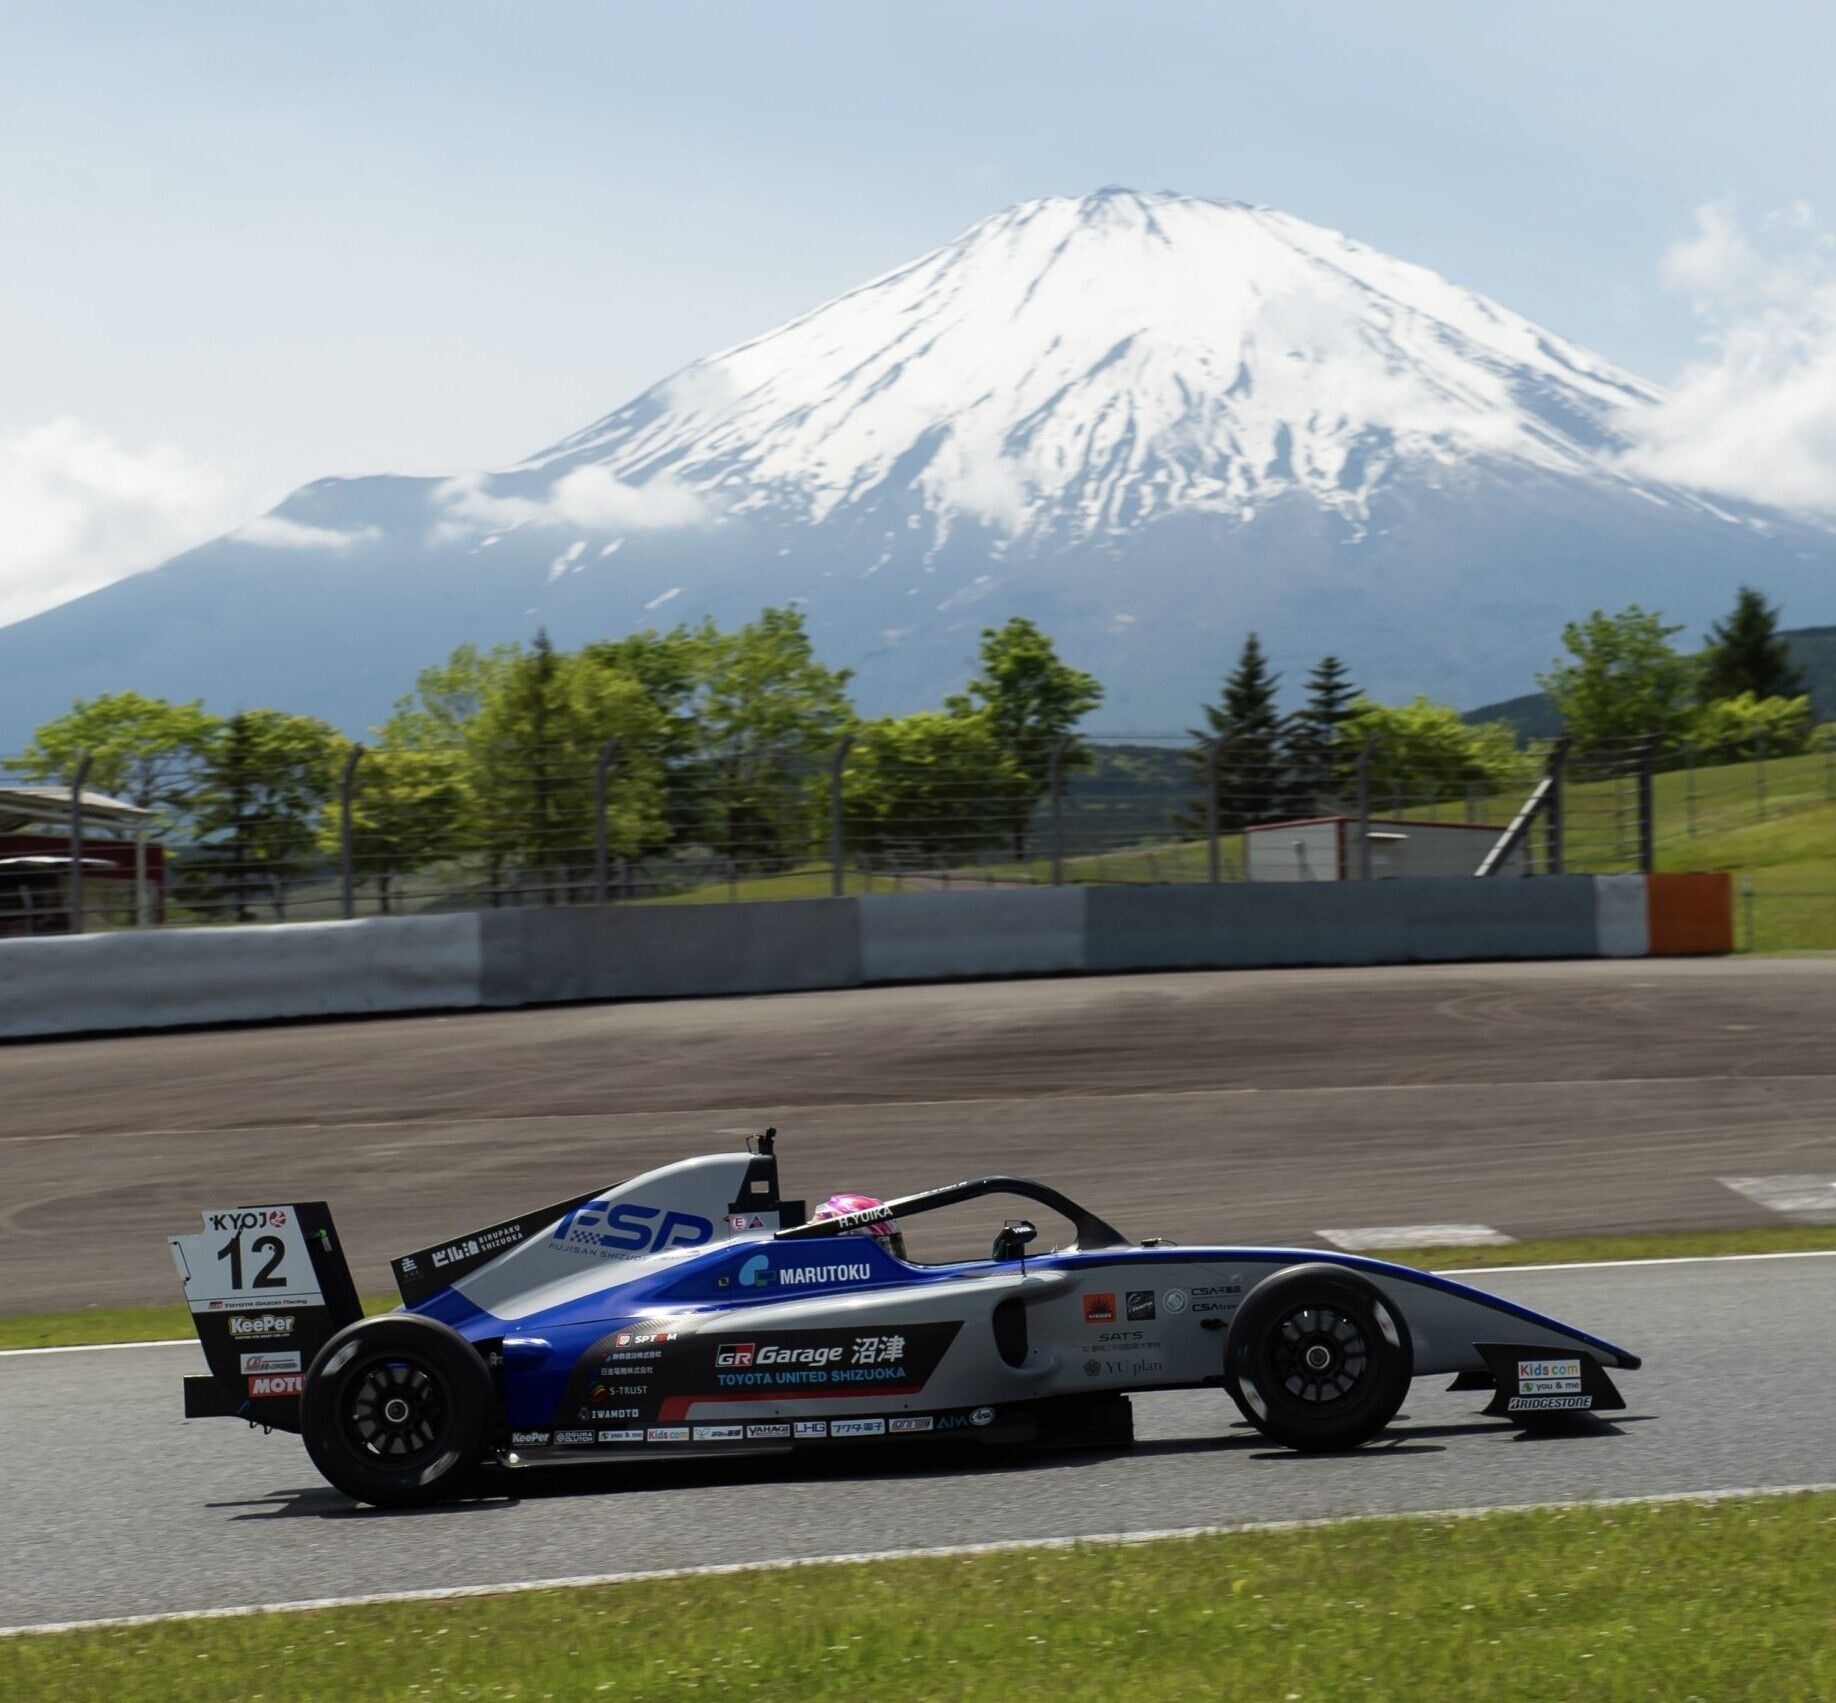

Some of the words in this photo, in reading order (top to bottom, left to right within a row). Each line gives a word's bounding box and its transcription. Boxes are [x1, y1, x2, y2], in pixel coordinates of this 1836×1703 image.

[553, 1200, 714, 1253] FSP
[838, 1206, 894, 1229] H.YUIKA
[480, 1232, 523, 1252] SHIZUOKA
[217, 1235, 288, 1290] 12
[779, 1263, 871, 1285] MARUTOKU
[230, 1314, 295, 1335] KeePer
[718, 1352, 752, 1366] GR
[756, 1346, 844, 1367] Garage
[850, 1335, 905, 1364] 沼津
[717, 1373, 773, 1386] TOYOTA
[775, 1370, 828, 1384] UNITED
[831, 1367, 907, 1382] SHIZUOKA
[1133, 1358, 1163, 1377] plan
[1520, 1363, 1549, 1377] Kids
[253, 1376, 305, 1395] MOTU
[609, 1385, 648, 1396] S-TRUST
[1536, 1383, 1553, 1393] you
[1565, 1380, 1579, 1389] me
[1510, 1396, 1592, 1410] BRIDGESTONE
[592, 1408, 640, 1419] IWAMOTO
[648, 1430, 669, 1440] Kids
[795, 1422, 826, 1433] LHG
[512, 1432, 550, 1443] KeePer
